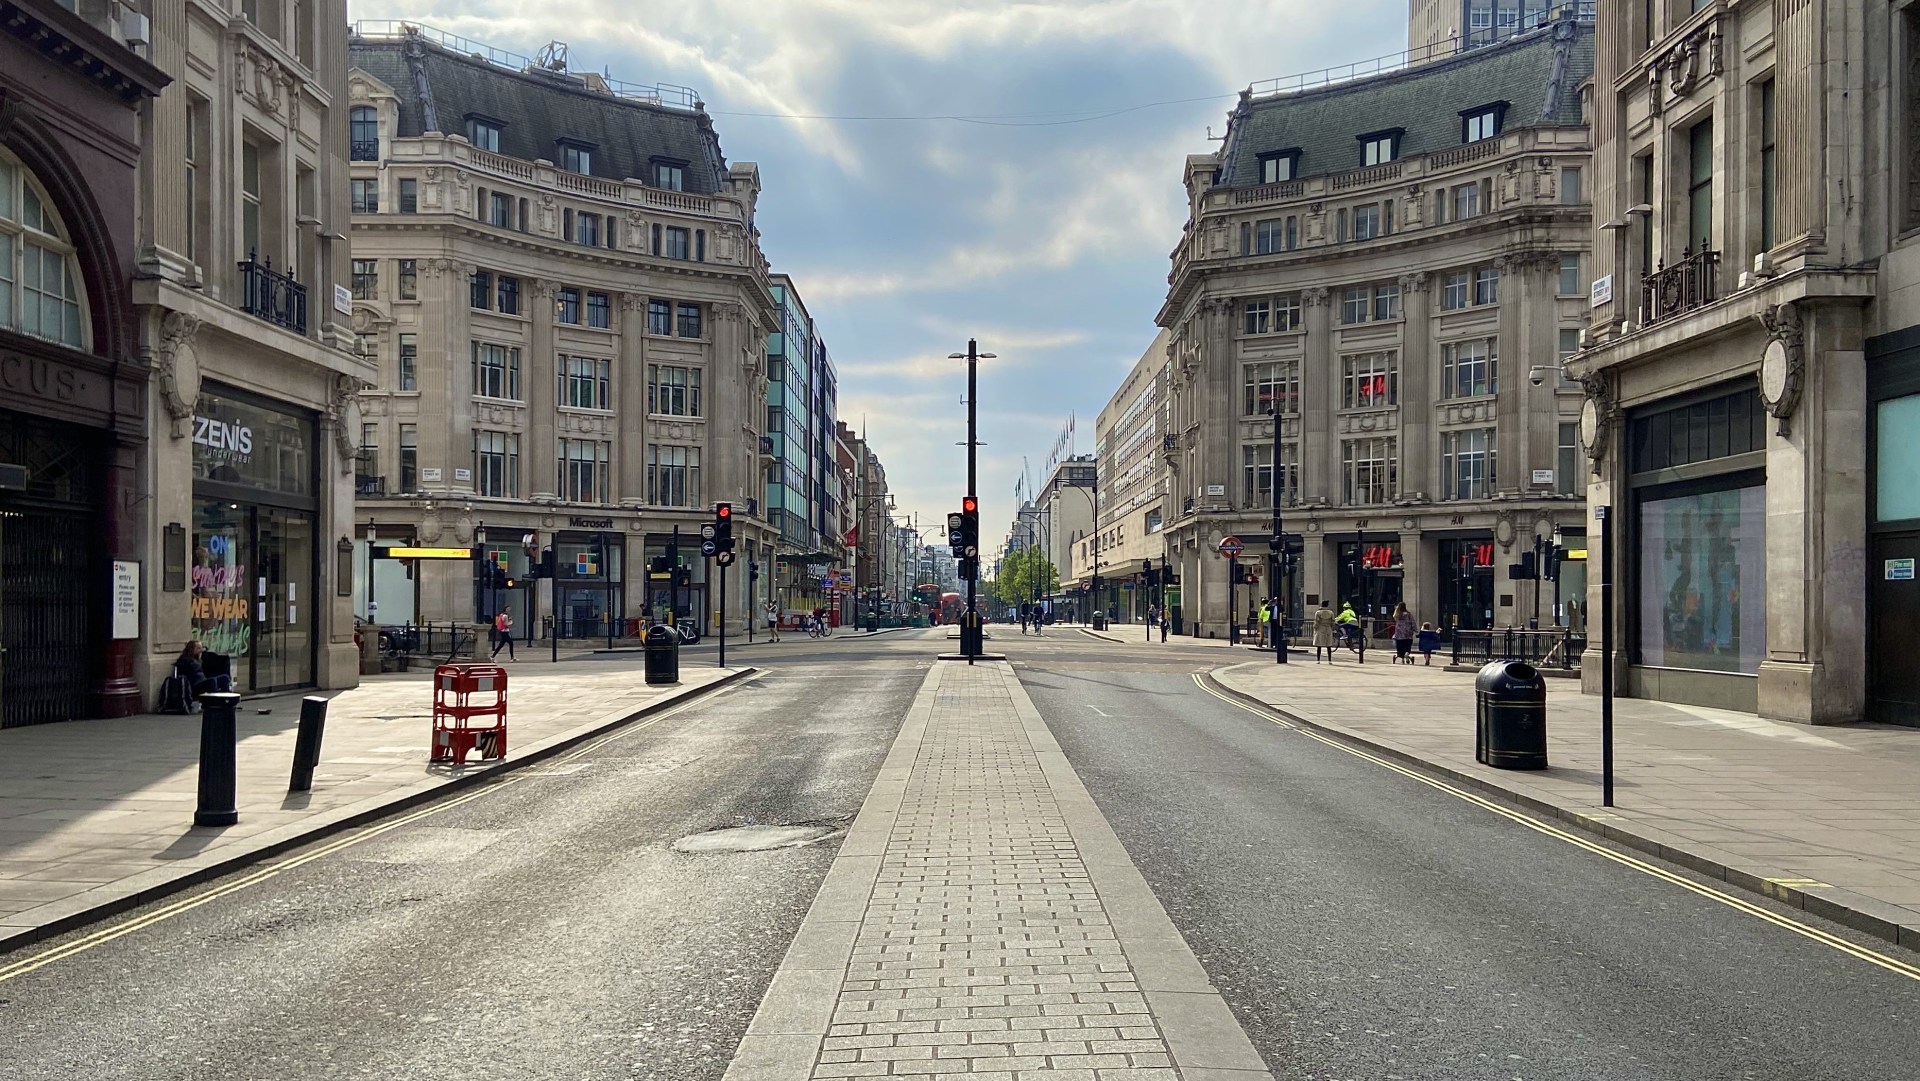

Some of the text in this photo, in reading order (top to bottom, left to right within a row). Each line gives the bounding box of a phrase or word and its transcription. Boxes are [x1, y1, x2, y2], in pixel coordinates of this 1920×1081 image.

[207, 448, 251, 464] underwear
[569, 517, 614, 529] Microsoft
[210, 535, 228, 554] ON
[119, 574, 131, 582] entry
[192, 598, 210, 619] WE
[211, 597, 248, 620] WEAR
